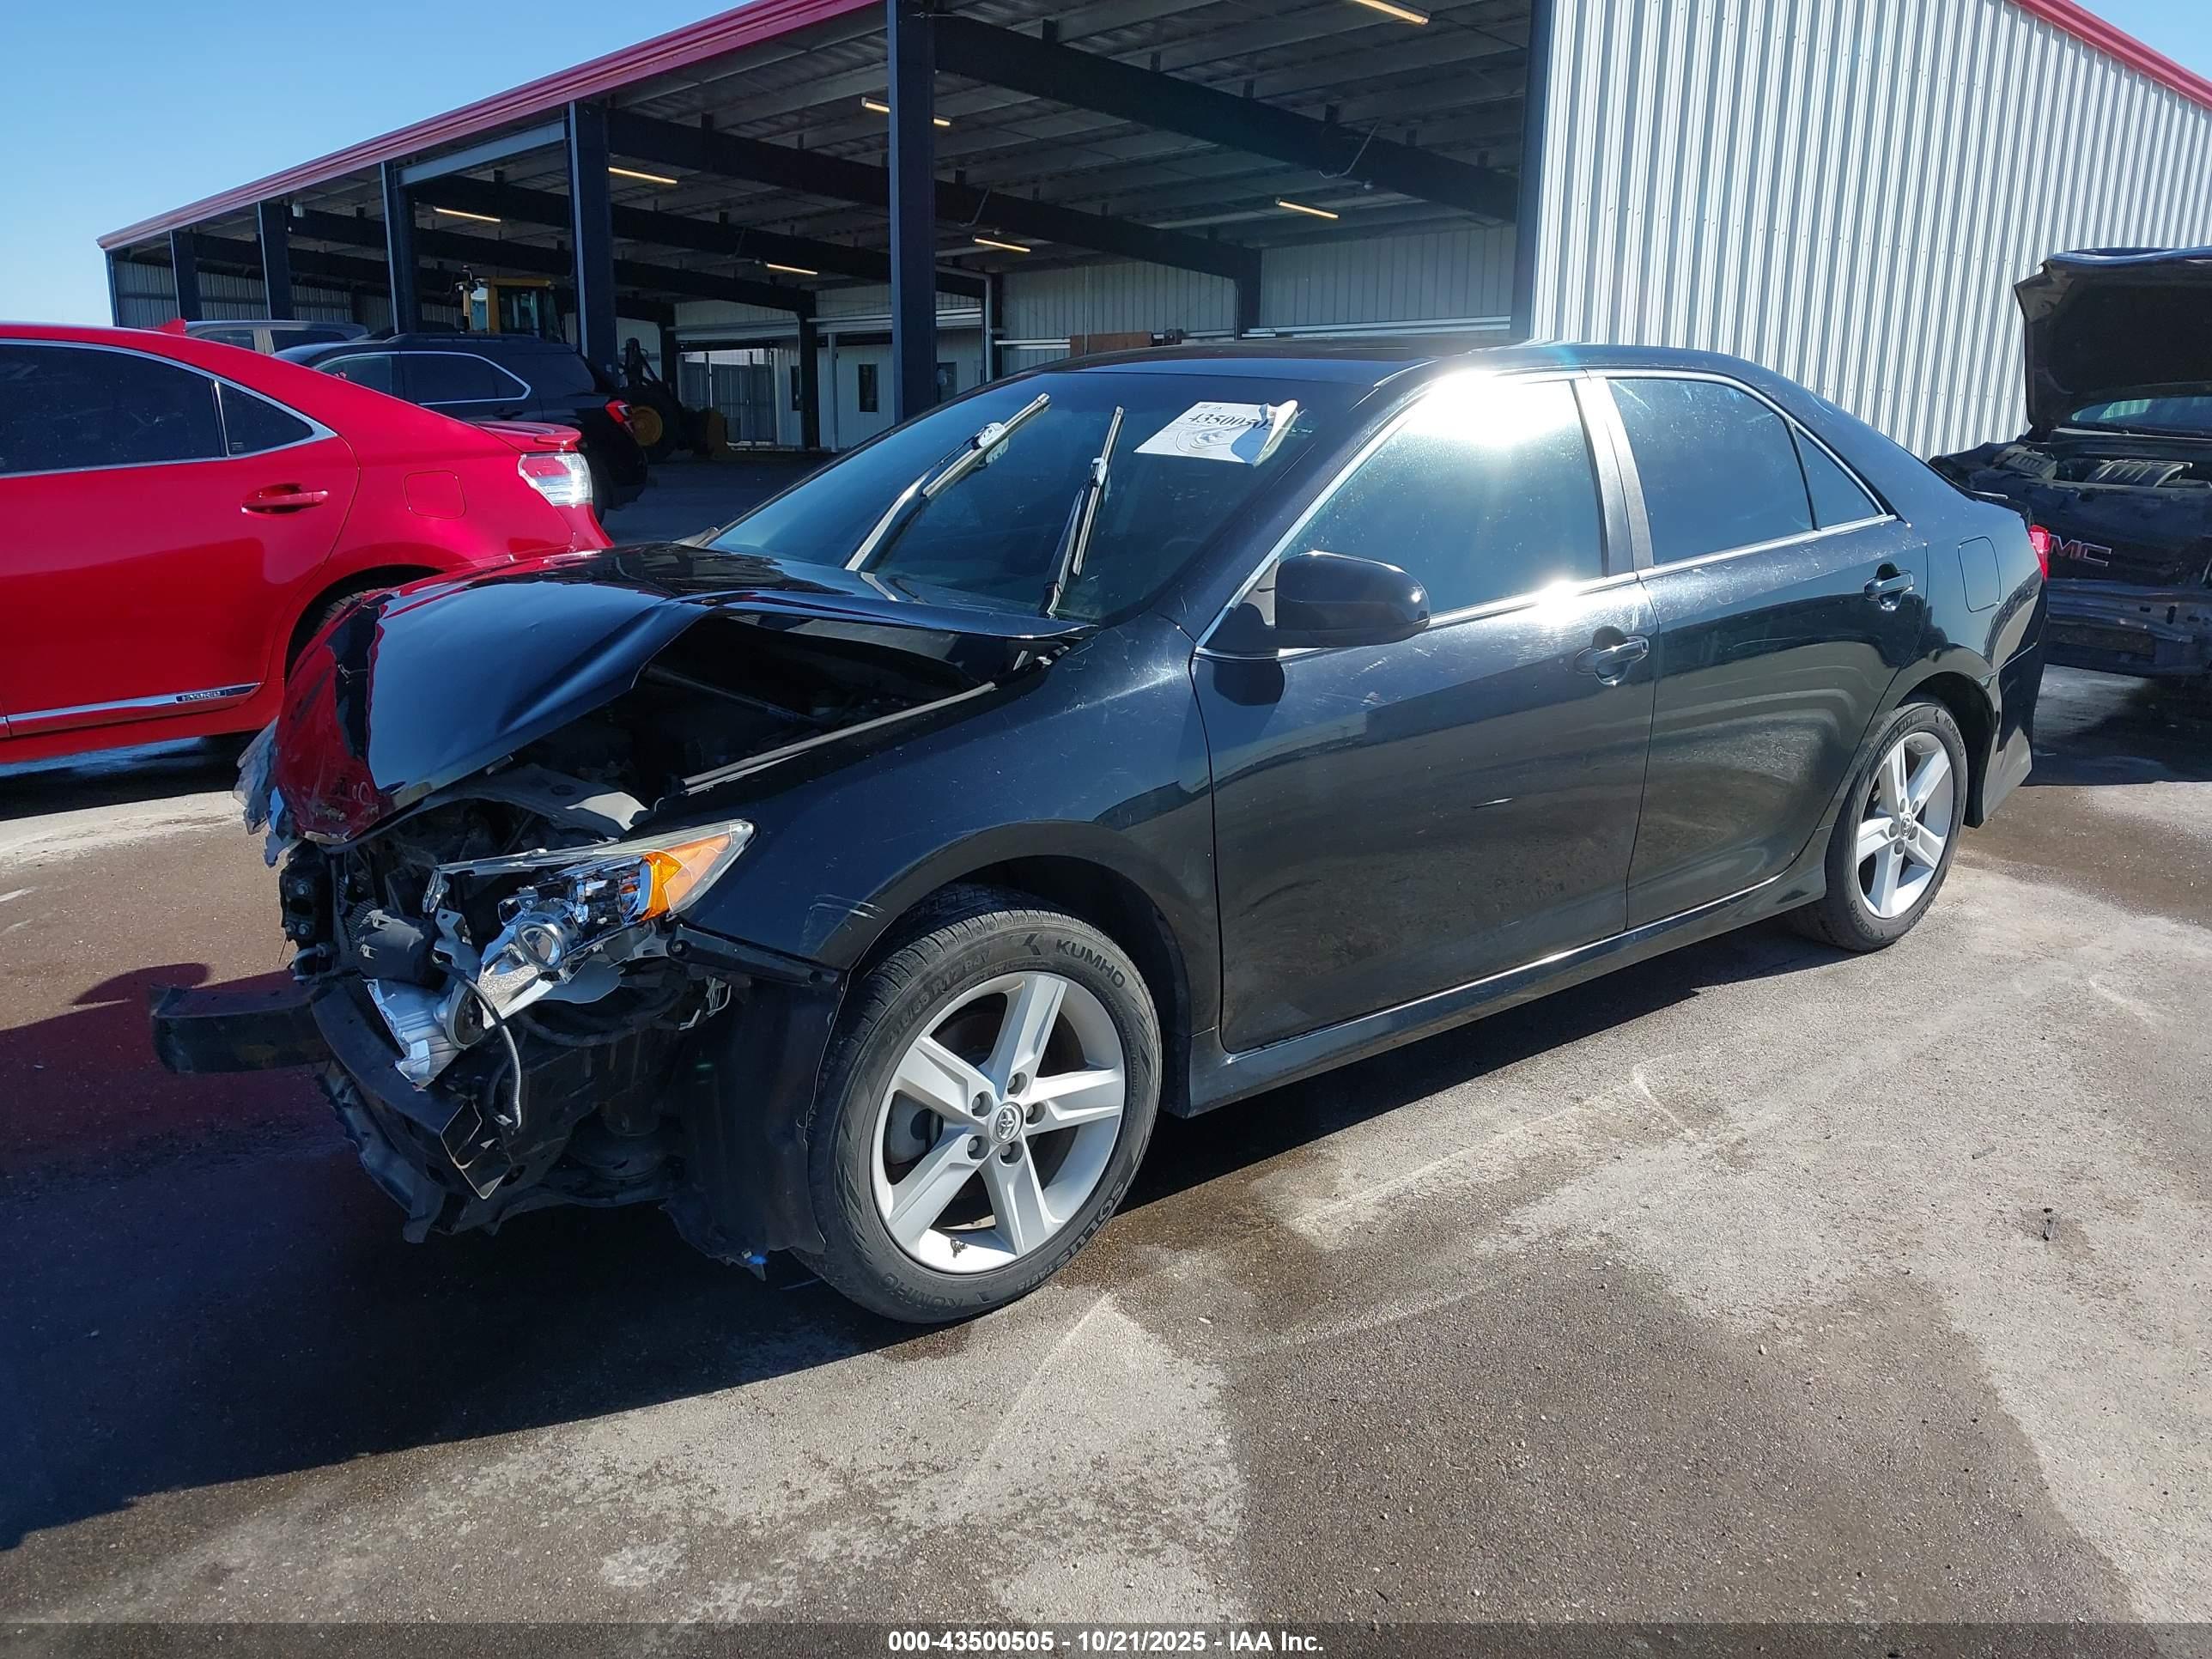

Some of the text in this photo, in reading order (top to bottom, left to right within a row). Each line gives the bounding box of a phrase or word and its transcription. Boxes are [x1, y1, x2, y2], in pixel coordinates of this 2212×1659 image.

[2049, 533, 2112, 567] MC
[1055, 939, 1127, 989] KUMHO
[1056, 1181, 1125, 1267] SOLUS
